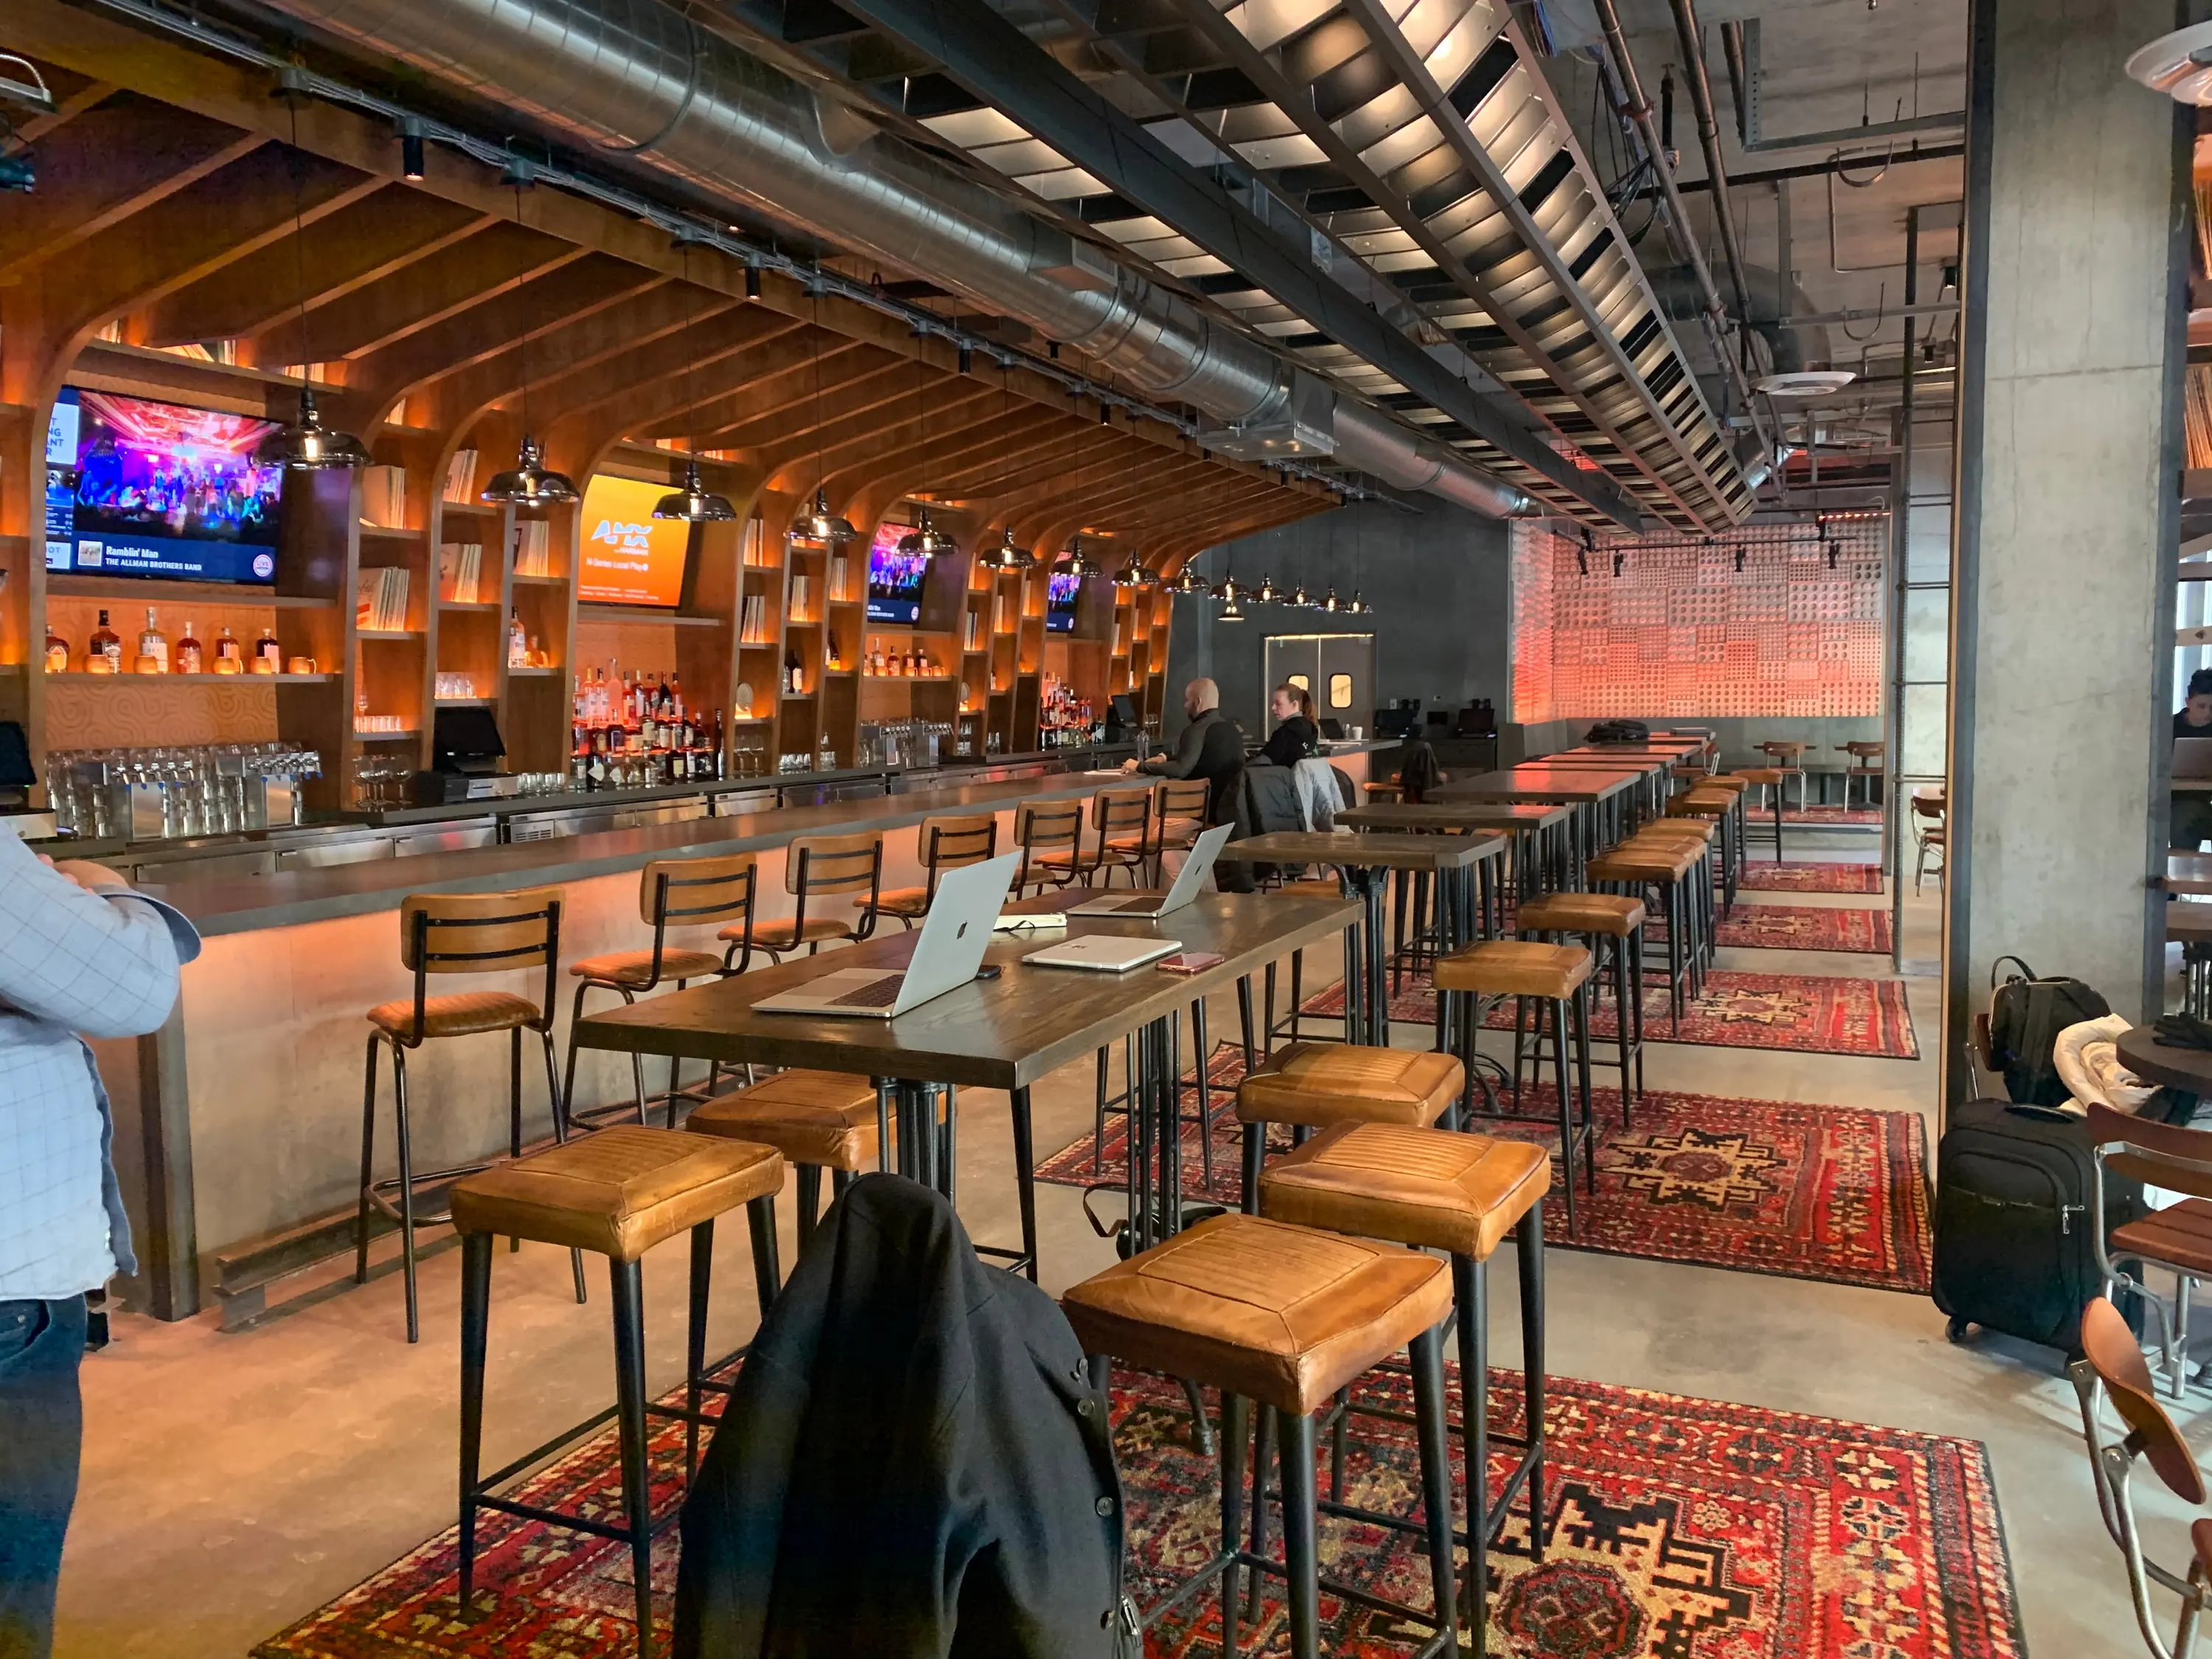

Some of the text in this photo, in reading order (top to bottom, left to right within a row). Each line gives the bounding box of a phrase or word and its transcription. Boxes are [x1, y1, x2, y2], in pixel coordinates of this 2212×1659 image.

[106, 546, 159, 558] Ramblin' Man
[105, 557, 119, 566] THE
[120, 559, 148, 567] ALLMAN
[149, 560, 184, 570] BROTHERS
